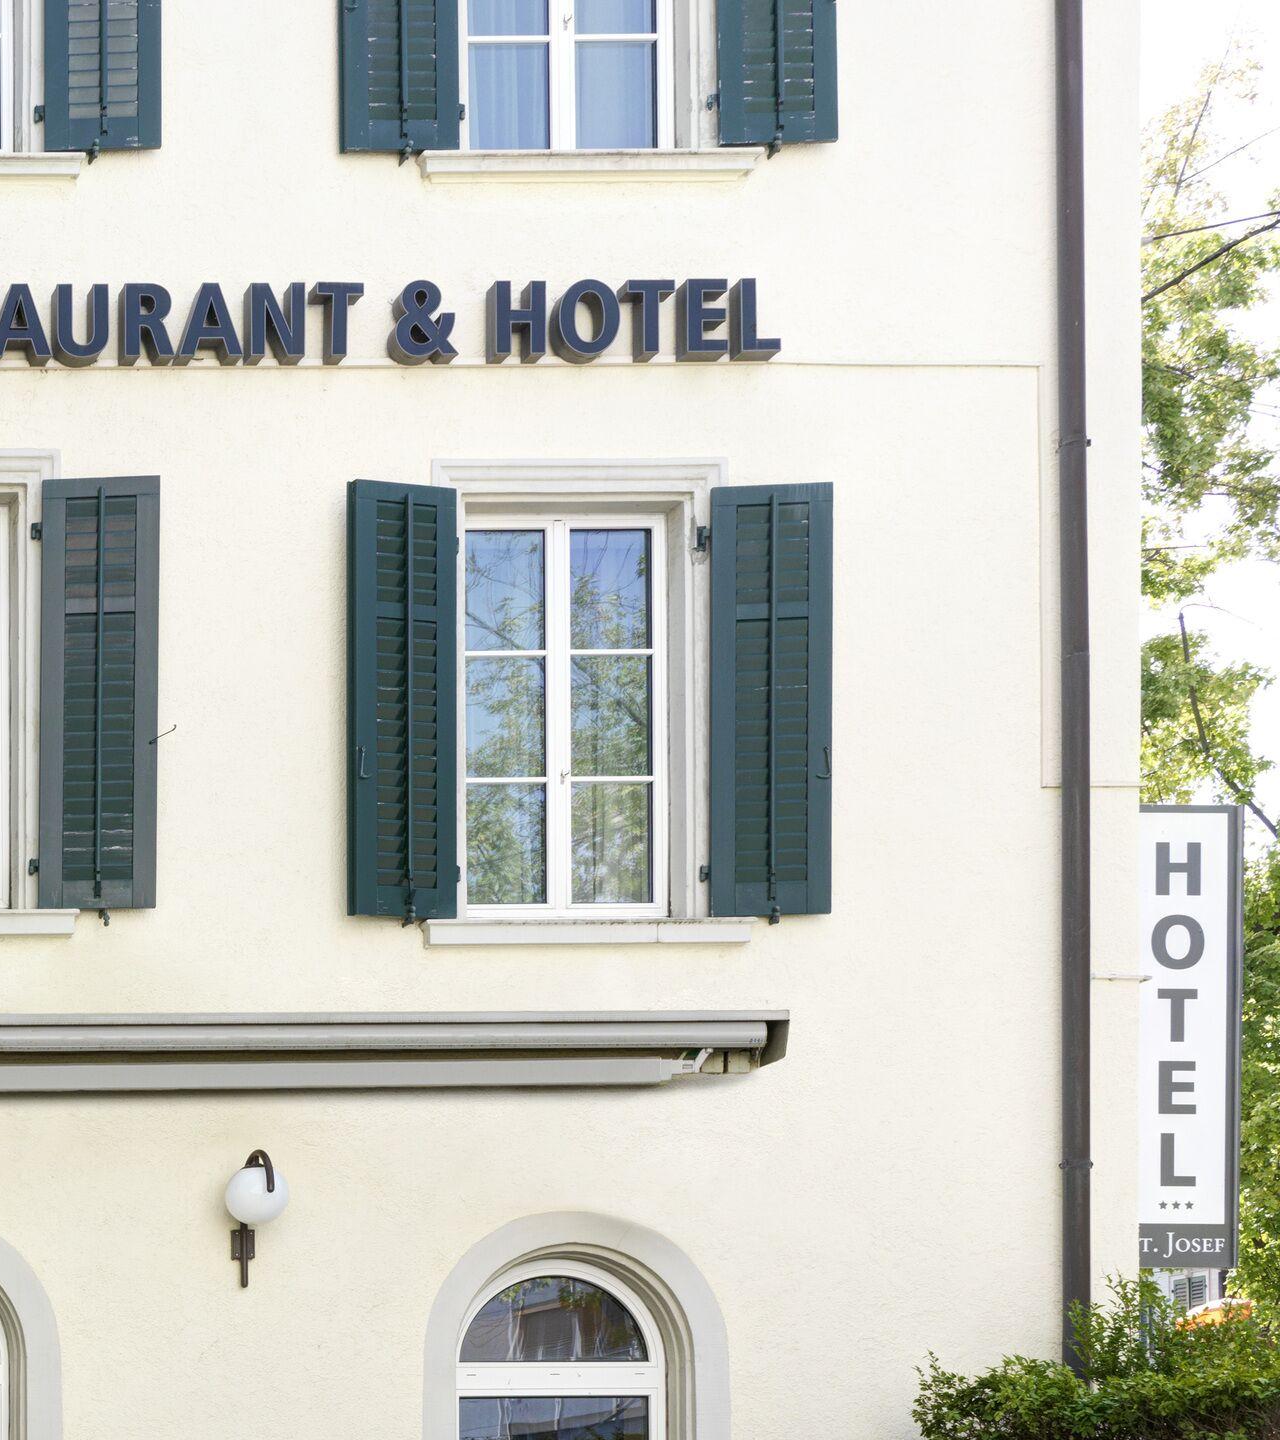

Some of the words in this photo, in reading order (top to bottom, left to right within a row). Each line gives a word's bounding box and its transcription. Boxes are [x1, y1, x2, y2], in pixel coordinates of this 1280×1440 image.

[387, 279, 459, 365] &
[485, 278, 781, 364] HOTEL
[1151, 842, 1205, 1187] HOTEL
[1139, 1237, 1158, 1253] T.
